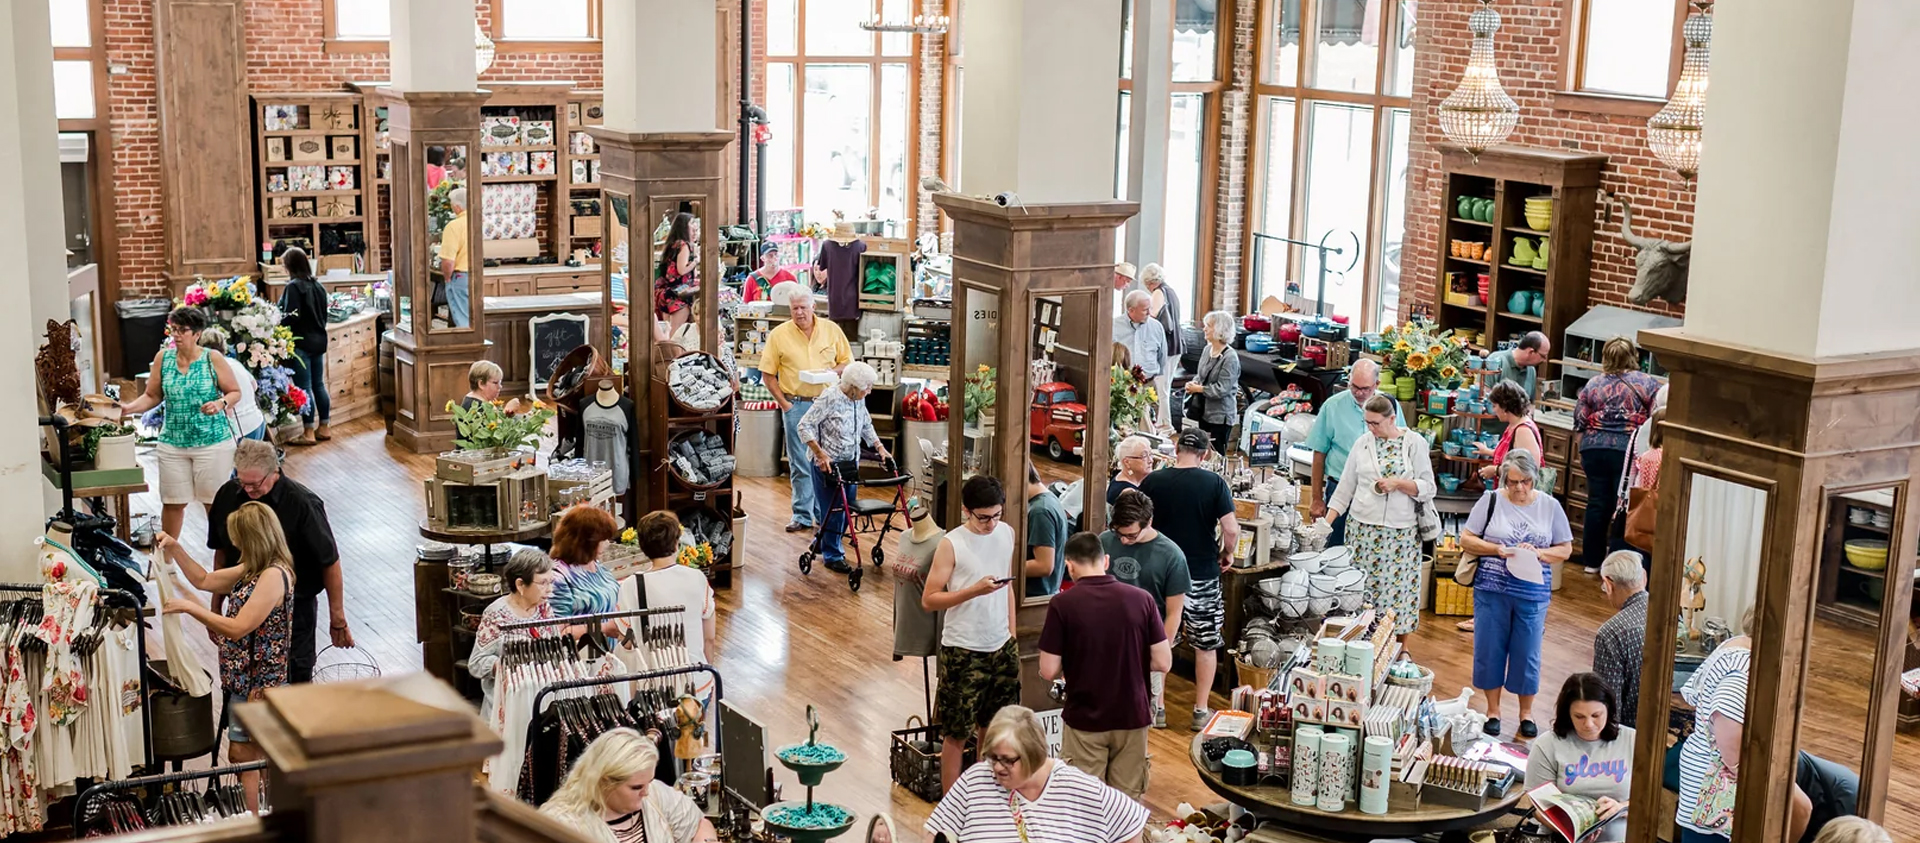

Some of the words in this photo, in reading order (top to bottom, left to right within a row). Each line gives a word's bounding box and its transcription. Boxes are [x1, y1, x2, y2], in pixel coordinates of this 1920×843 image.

[545, 328, 574, 347] gift
[1042, 715, 1059, 735] VE
[1049, 743, 1061, 758] IS
[1564, 753, 1628, 786] glory
